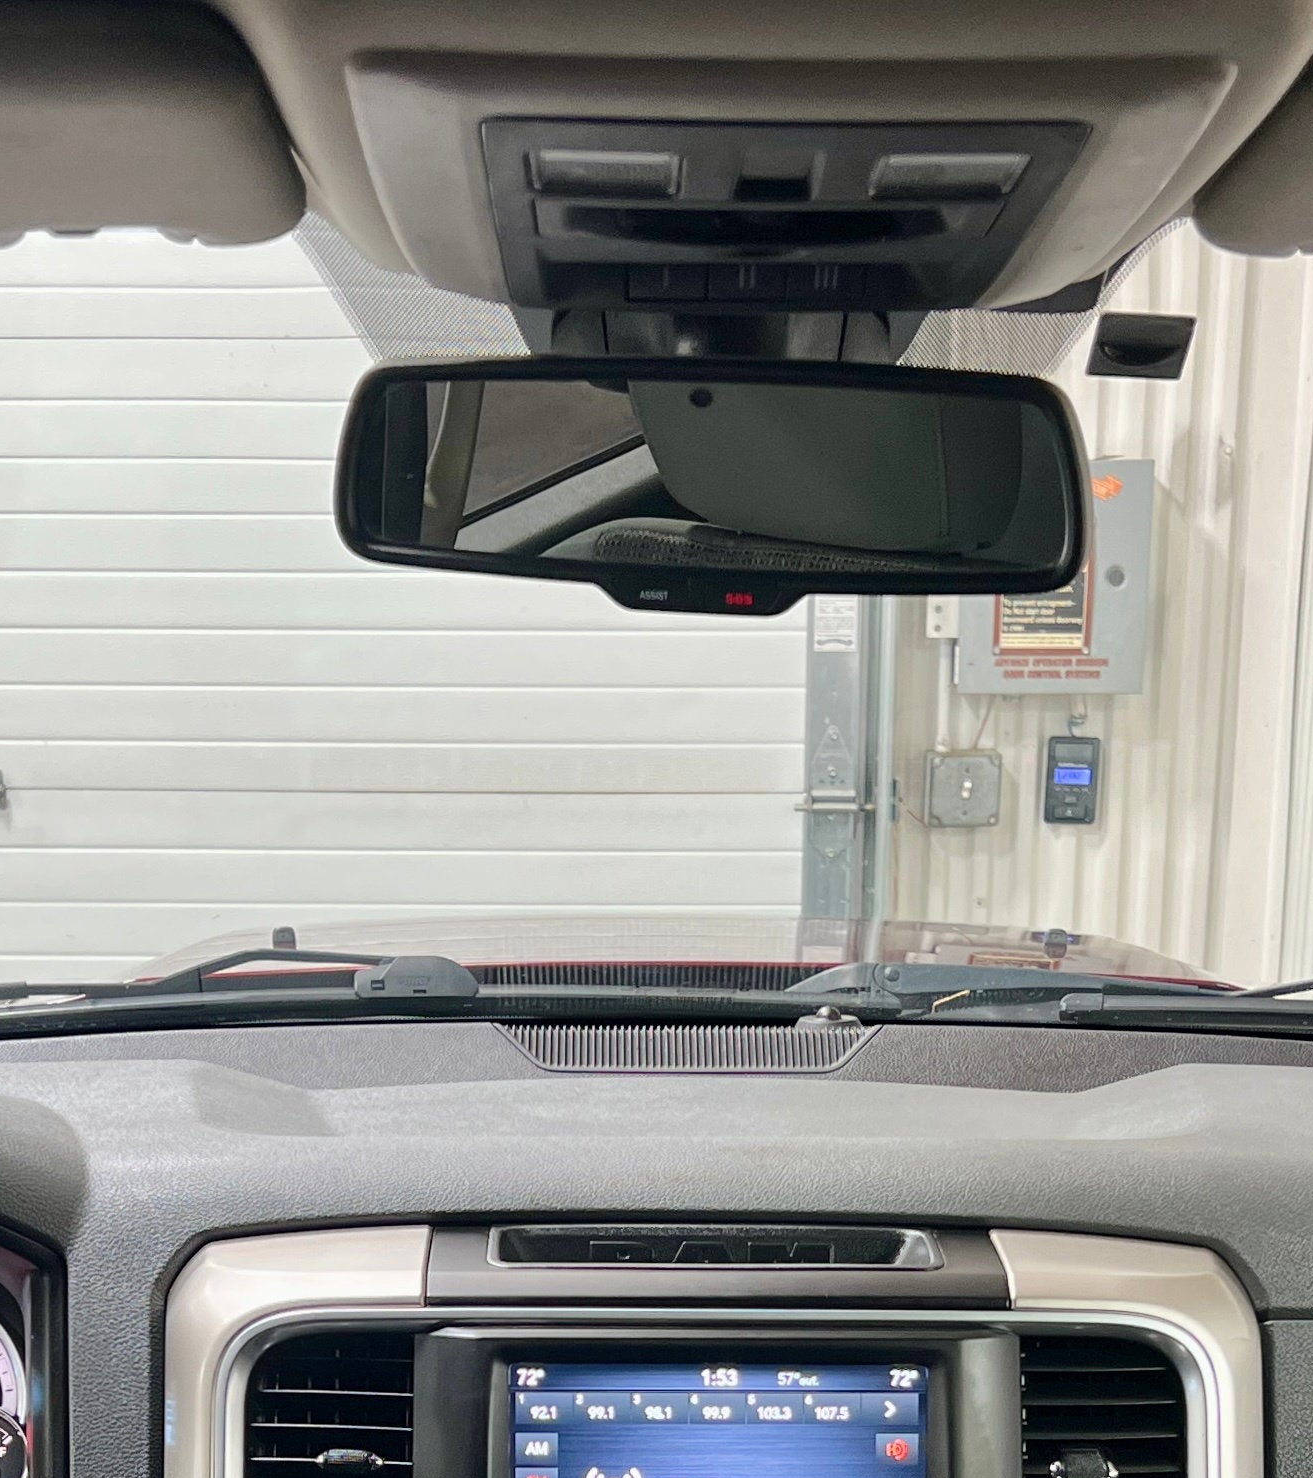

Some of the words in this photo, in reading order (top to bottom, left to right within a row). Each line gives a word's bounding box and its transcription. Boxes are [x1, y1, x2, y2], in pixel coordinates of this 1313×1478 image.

[639, 590, 668, 600] ASSIST
[700, 1368, 738, 1386] 1:53
[530, 1406, 557, 1420] 92.1
[587, 1406, 615, 1420] 99.1
[524, 1441, 549, 1456] AM
